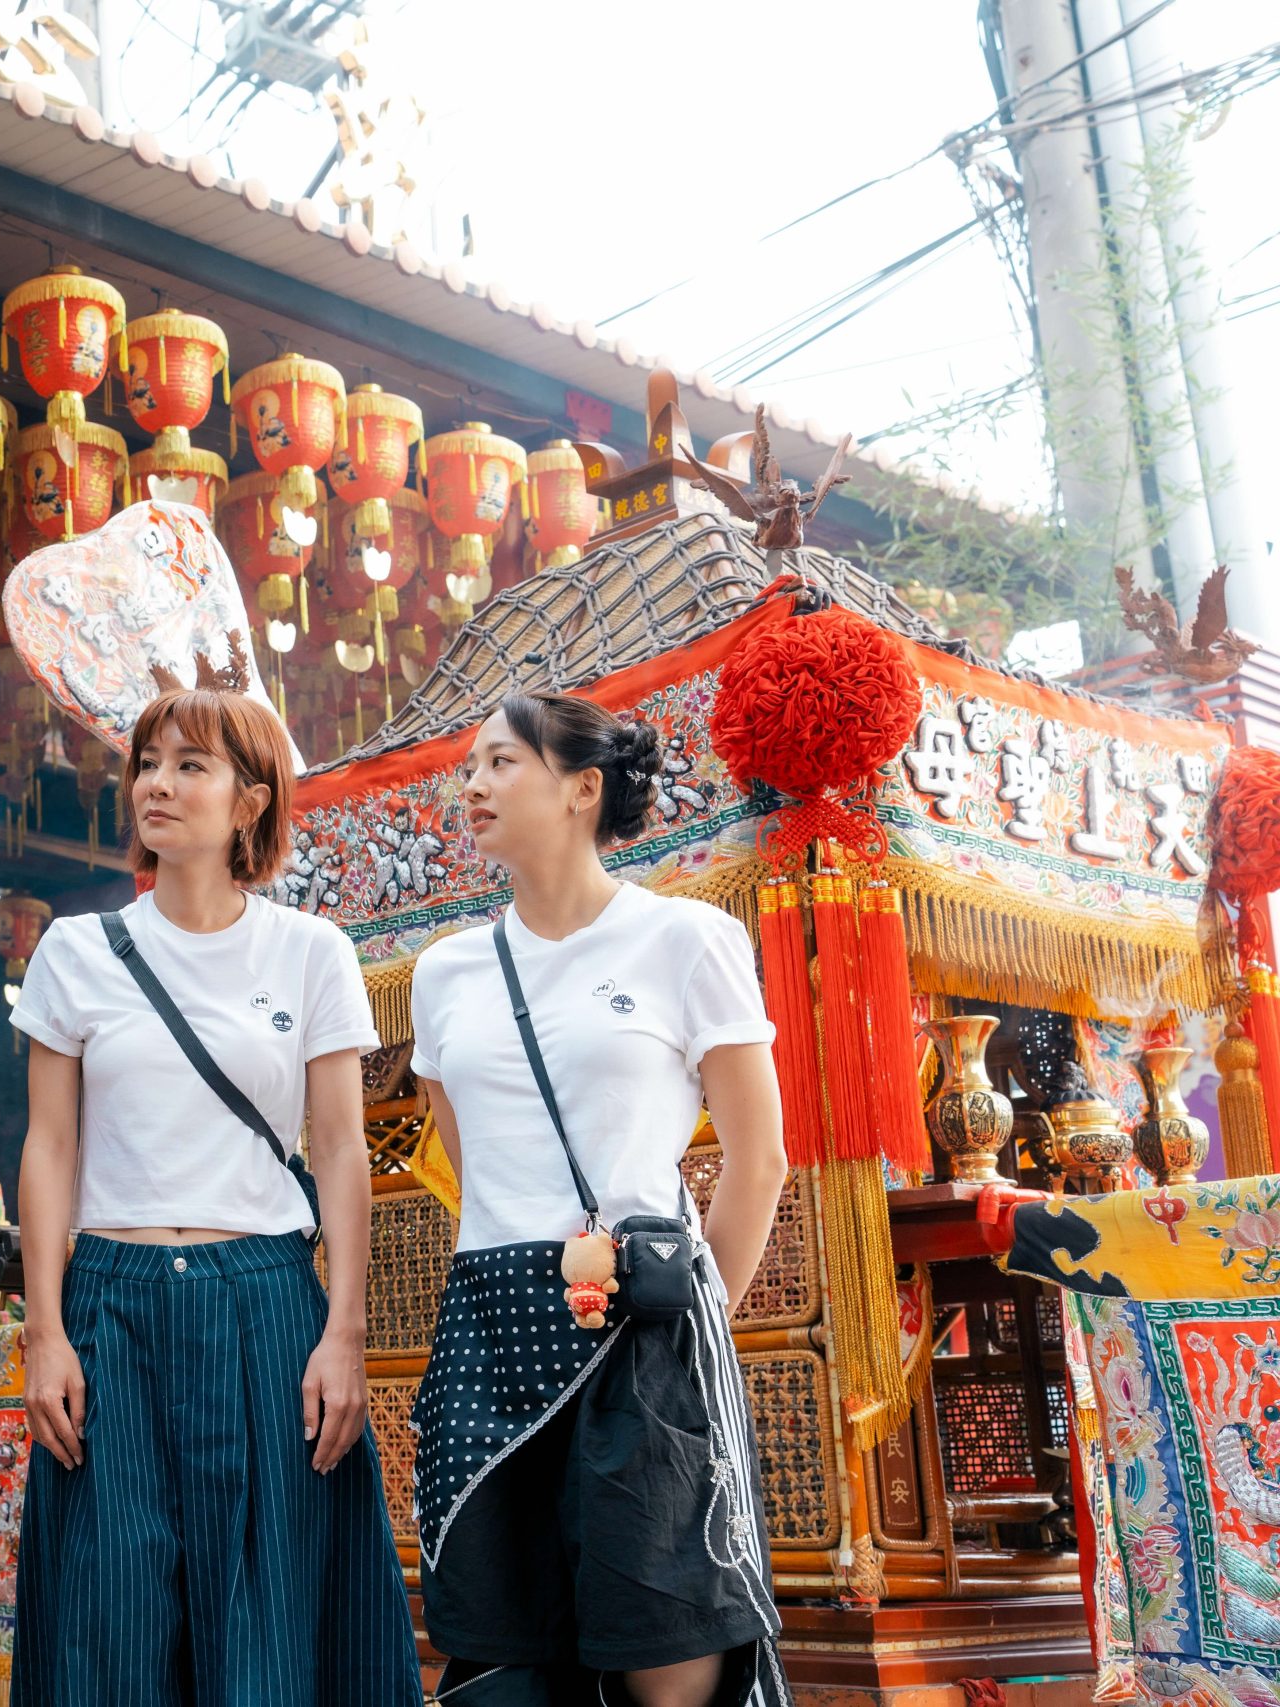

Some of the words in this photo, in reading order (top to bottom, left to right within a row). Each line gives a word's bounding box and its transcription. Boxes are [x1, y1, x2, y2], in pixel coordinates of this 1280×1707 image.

[654, 434, 668, 455] 中
[588, 463, 603, 479] 田
[255, 997, 269, 1005] Hi
[1142, 1185, 1189, 1246] 中
